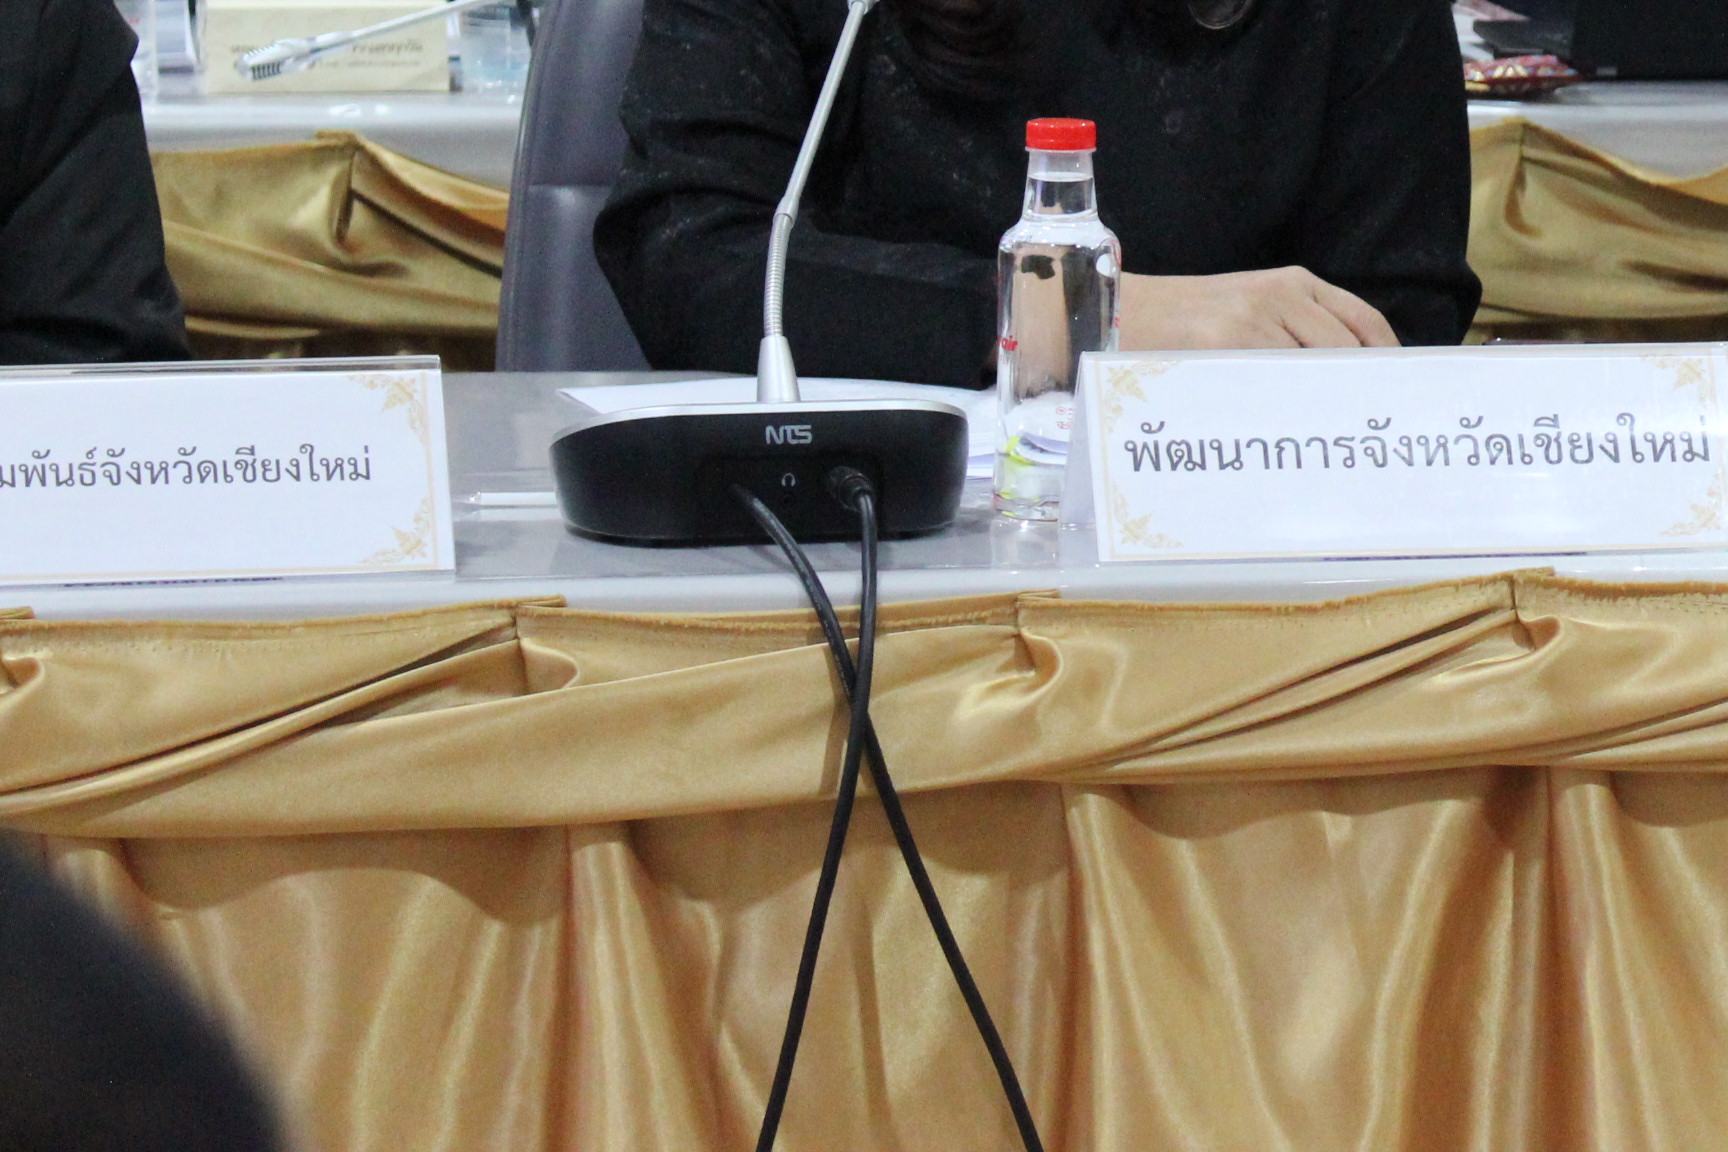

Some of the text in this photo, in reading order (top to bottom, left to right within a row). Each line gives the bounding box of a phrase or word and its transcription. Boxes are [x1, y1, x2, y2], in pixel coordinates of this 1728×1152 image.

[765, 424, 813, 445] NTS
[1123, 412, 1712, 473] พัฒนาการจังหวัดเชียงใหม่
